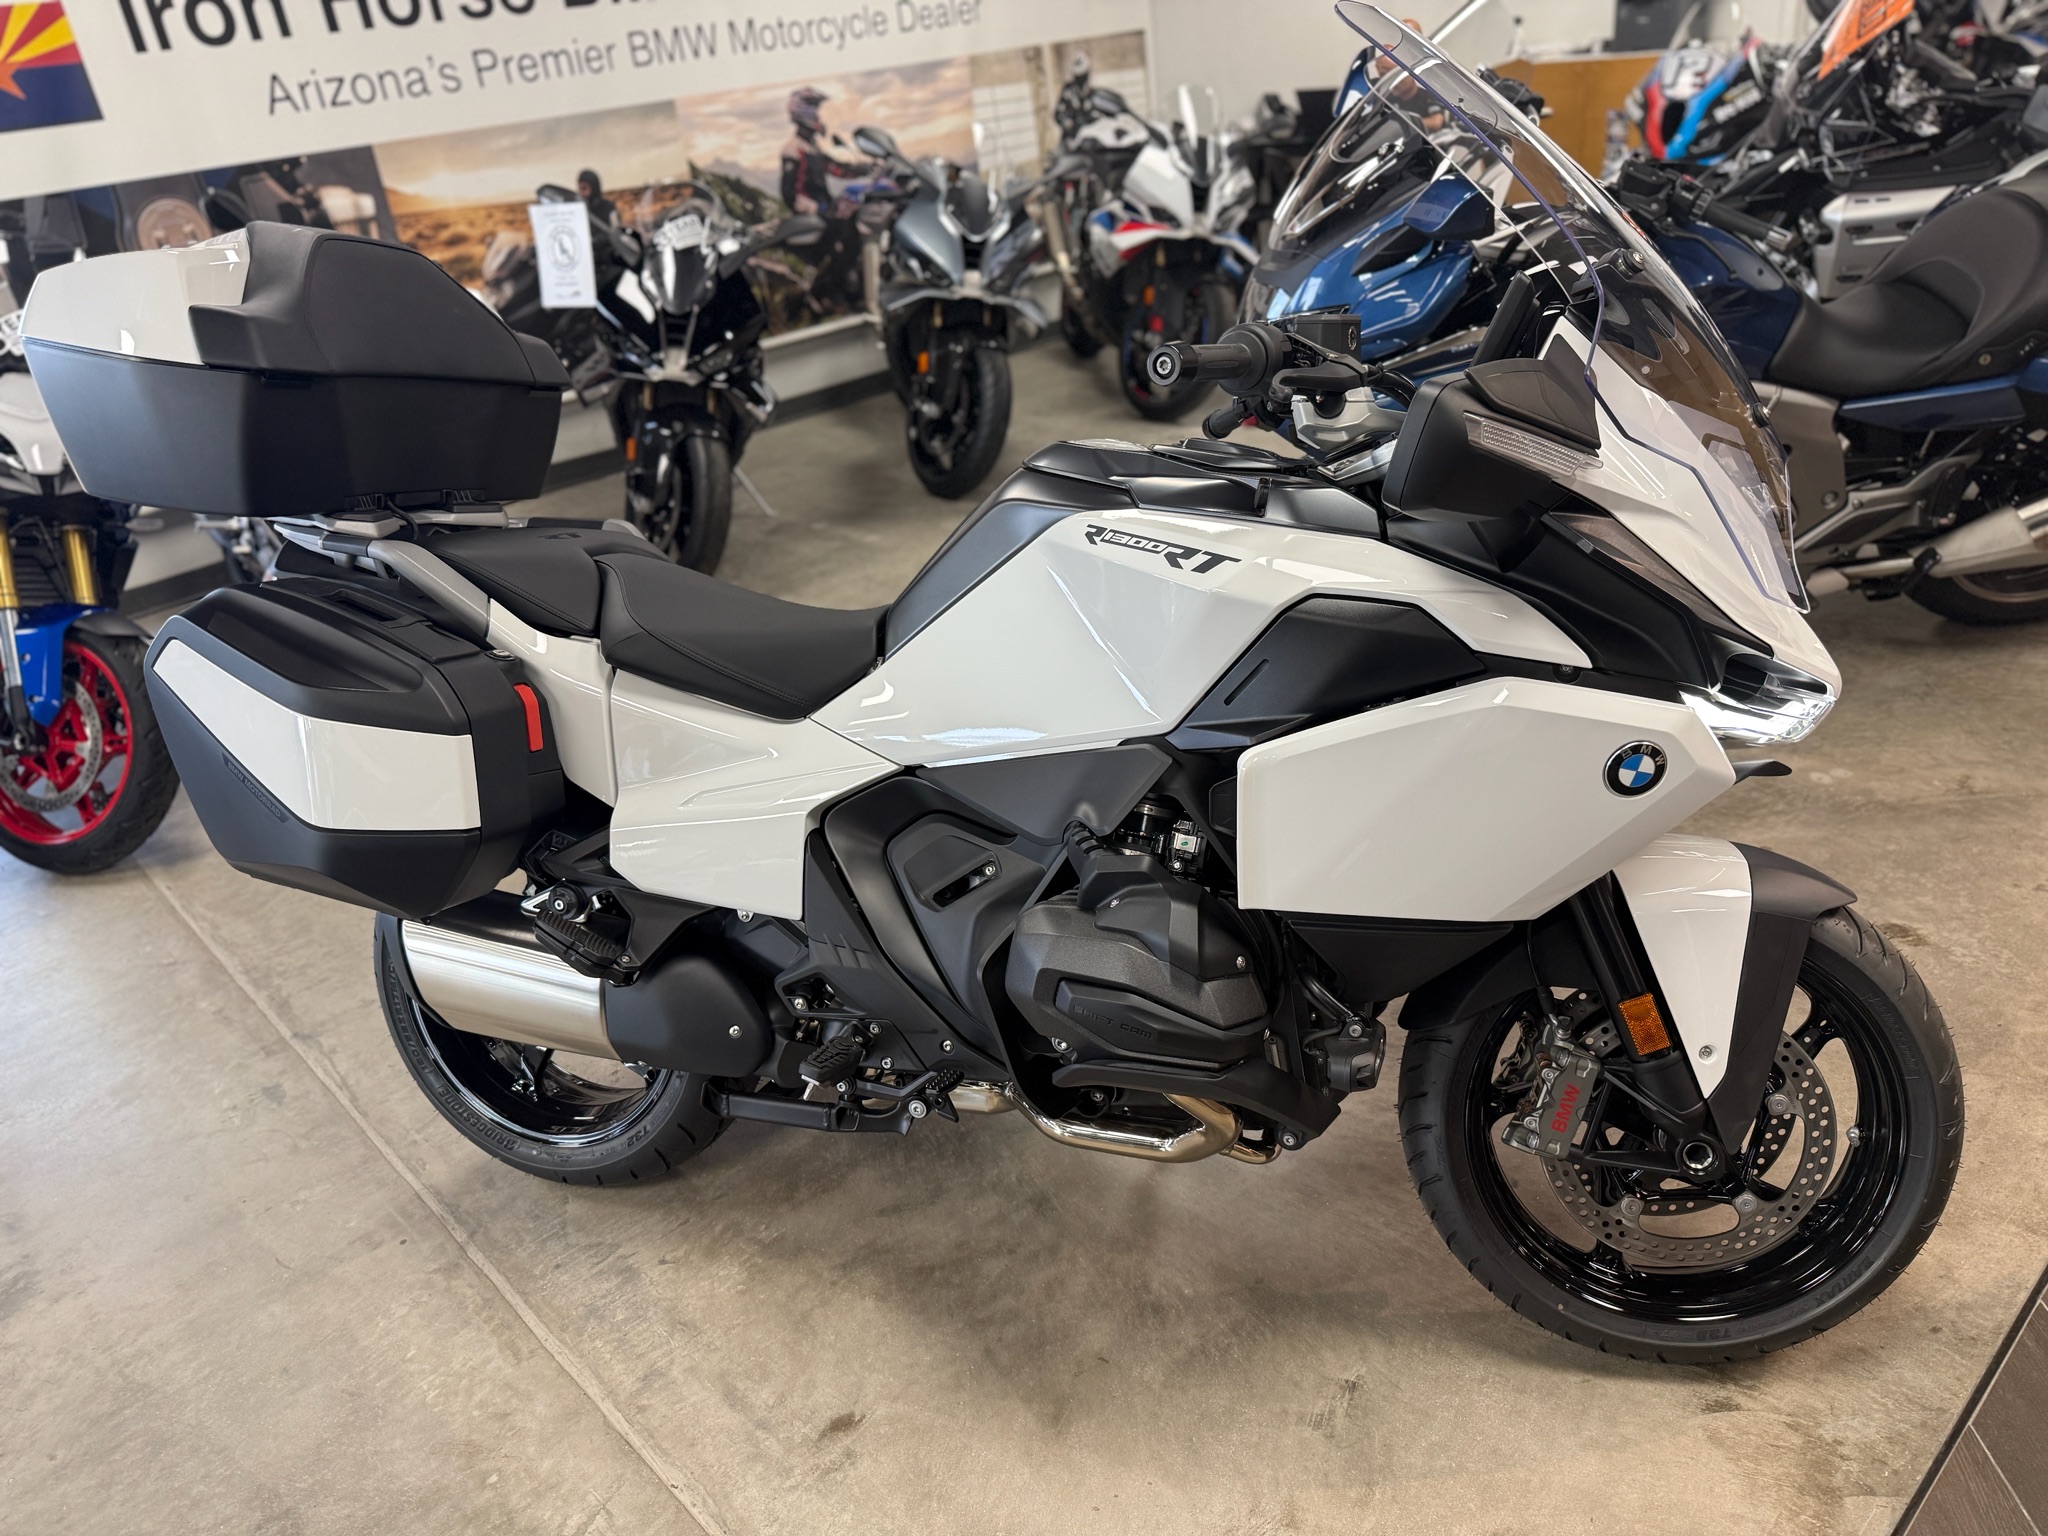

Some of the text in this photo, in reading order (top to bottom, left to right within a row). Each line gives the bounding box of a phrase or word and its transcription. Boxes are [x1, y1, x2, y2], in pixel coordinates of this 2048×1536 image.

[119, 0, 293, 53] Iron
[268, 0, 984, 116] Arizona's Premier BMW Motorcycle Dealer
[438, 1088, 518, 1152] BRIDGESTONE
[1551, 1082, 1581, 1133] BMW
[627, 1124, 651, 1147] T32
